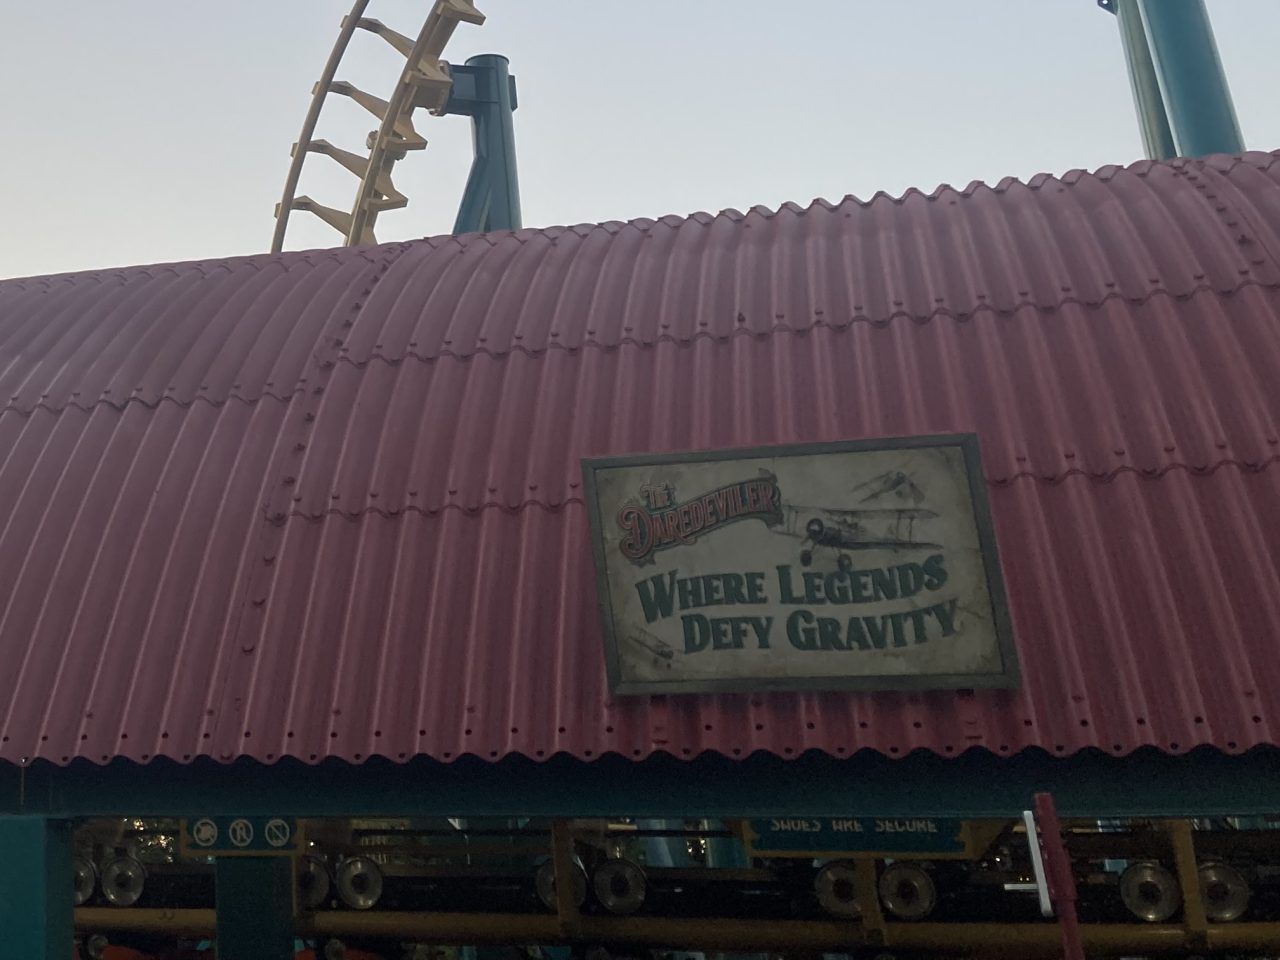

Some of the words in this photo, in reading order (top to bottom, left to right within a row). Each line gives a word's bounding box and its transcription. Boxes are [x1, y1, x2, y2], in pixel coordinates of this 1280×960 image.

[636, 569, 768, 625] WHERE
[777, 554, 949, 605] LEGENDS
[681, 615, 774, 654] DEFY
[787, 600, 958, 652] GRAVITY
